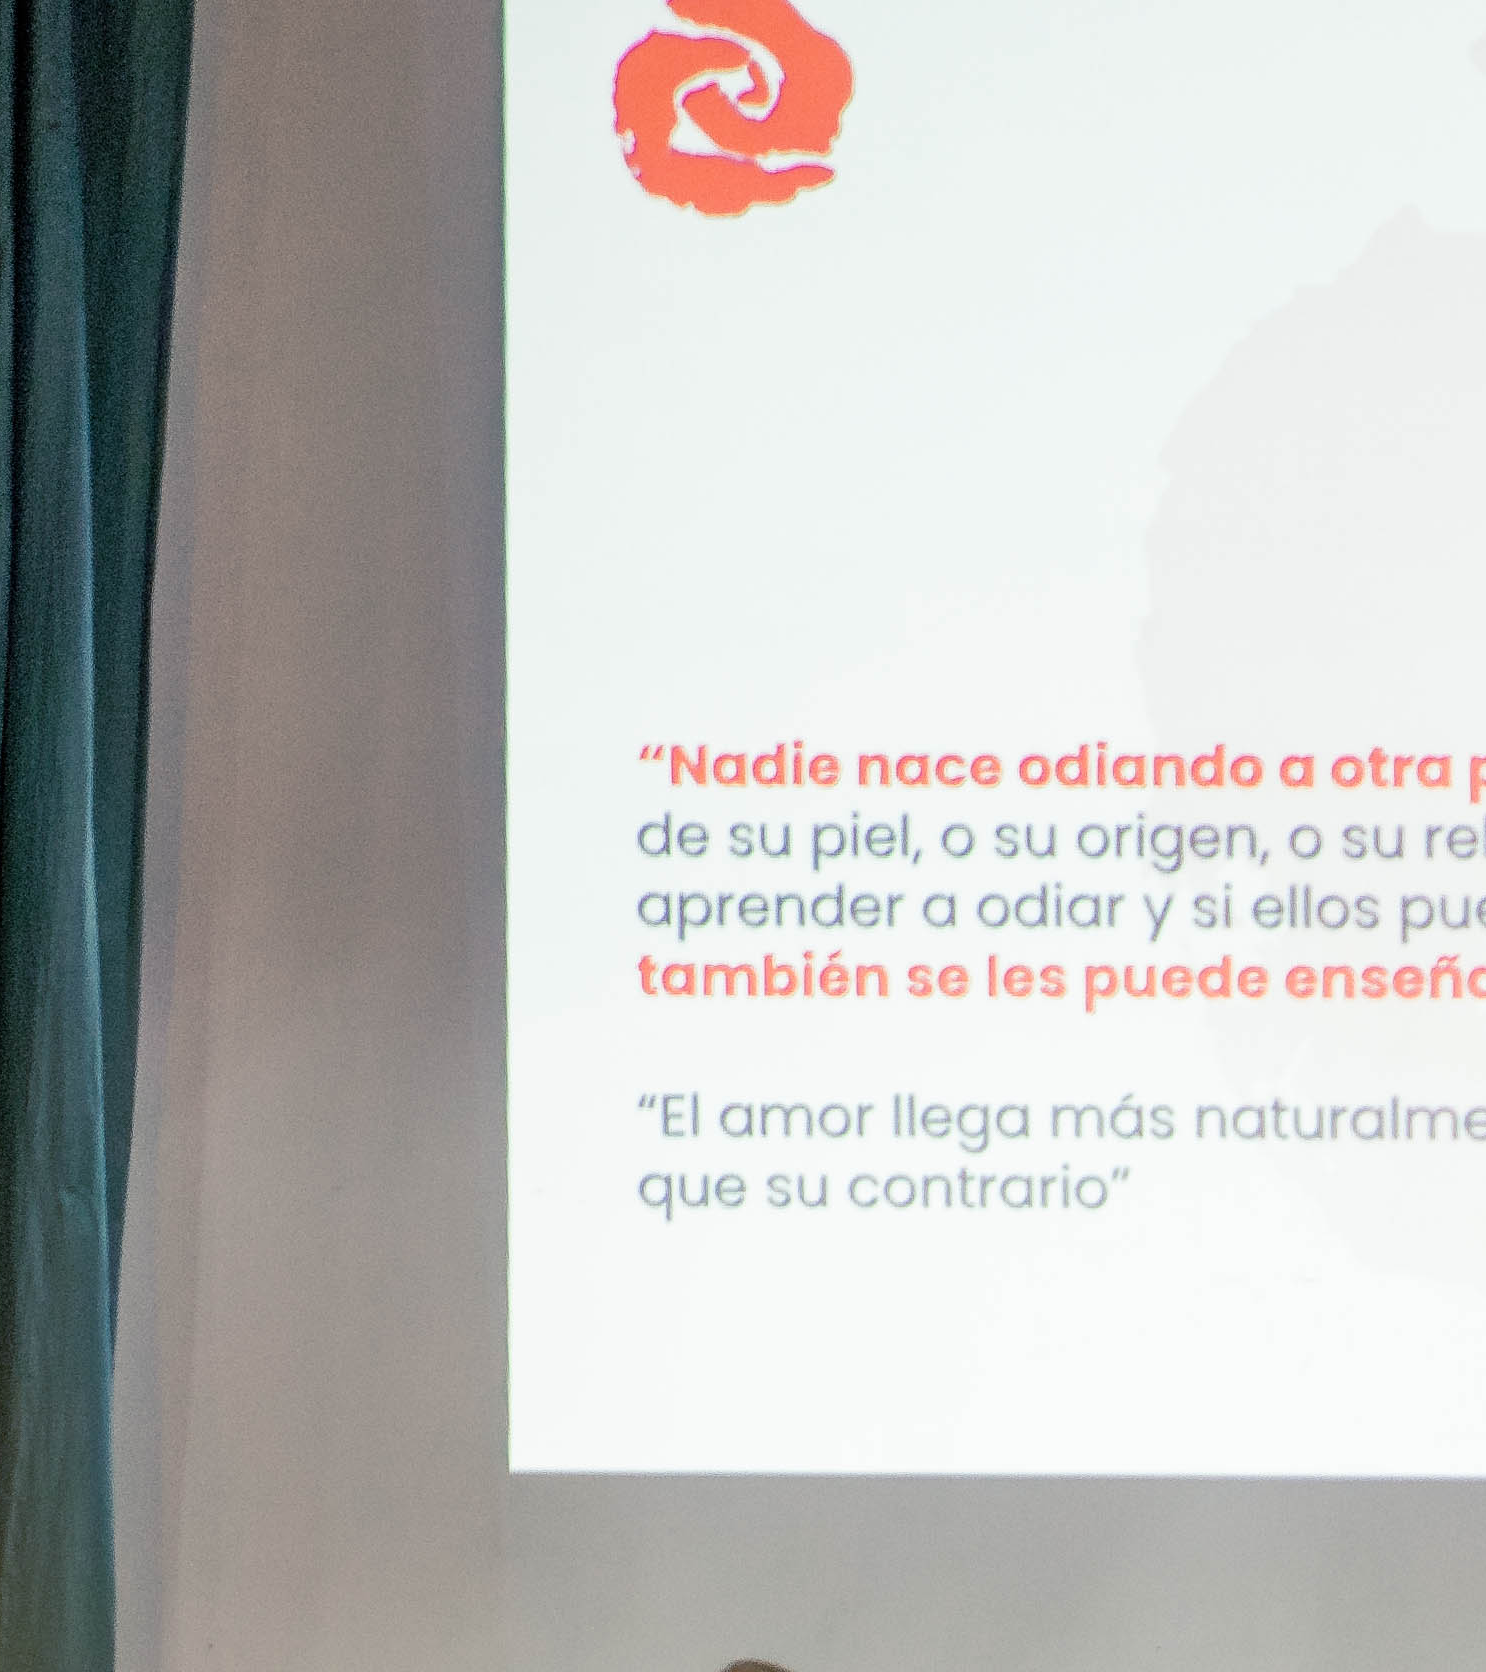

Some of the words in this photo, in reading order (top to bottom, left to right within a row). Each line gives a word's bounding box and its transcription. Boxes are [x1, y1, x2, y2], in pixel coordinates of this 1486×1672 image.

[857, 753, 1004, 789] nace
[1017, 742, 1265, 789] odiando
[1278, 754, 1316, 789] a
[1330, 746, 1453, 789] otra
[636, 811, 710, 859] de
[729, 822, 792, 859] su
[811, 811, 923, 873] piel,
[940, 823, 976, 860] o
[994, 823, 1057, 860] su
[1076, 813, 1269, 876] origen,
[1288, 824, 1323, 860] o
[1342, 825, 1404, 861] su
[636, 882, 905, 943] aprender
[922, 893, 957, 929] a
[976, 882, 1125, 929] odiar
[1143, 894, 1174, 943] y
[1192, 883, 1232, 930] si
[1251, 884, 1380, 930] ellos
[636, 951, 890, 999] también
[907, 964, 971, 999] se
[987, 954, 1068, 999] les
[1084, 954, 1270, 1015] puede
[719, 1103, 874, 1139] amor
[893, 1093, 1030, 1155] llega
[1051, 1093, 1175, 1140] más
[637, 1172, 747, 1222] que
[766, 1174, 828, 1209] su
